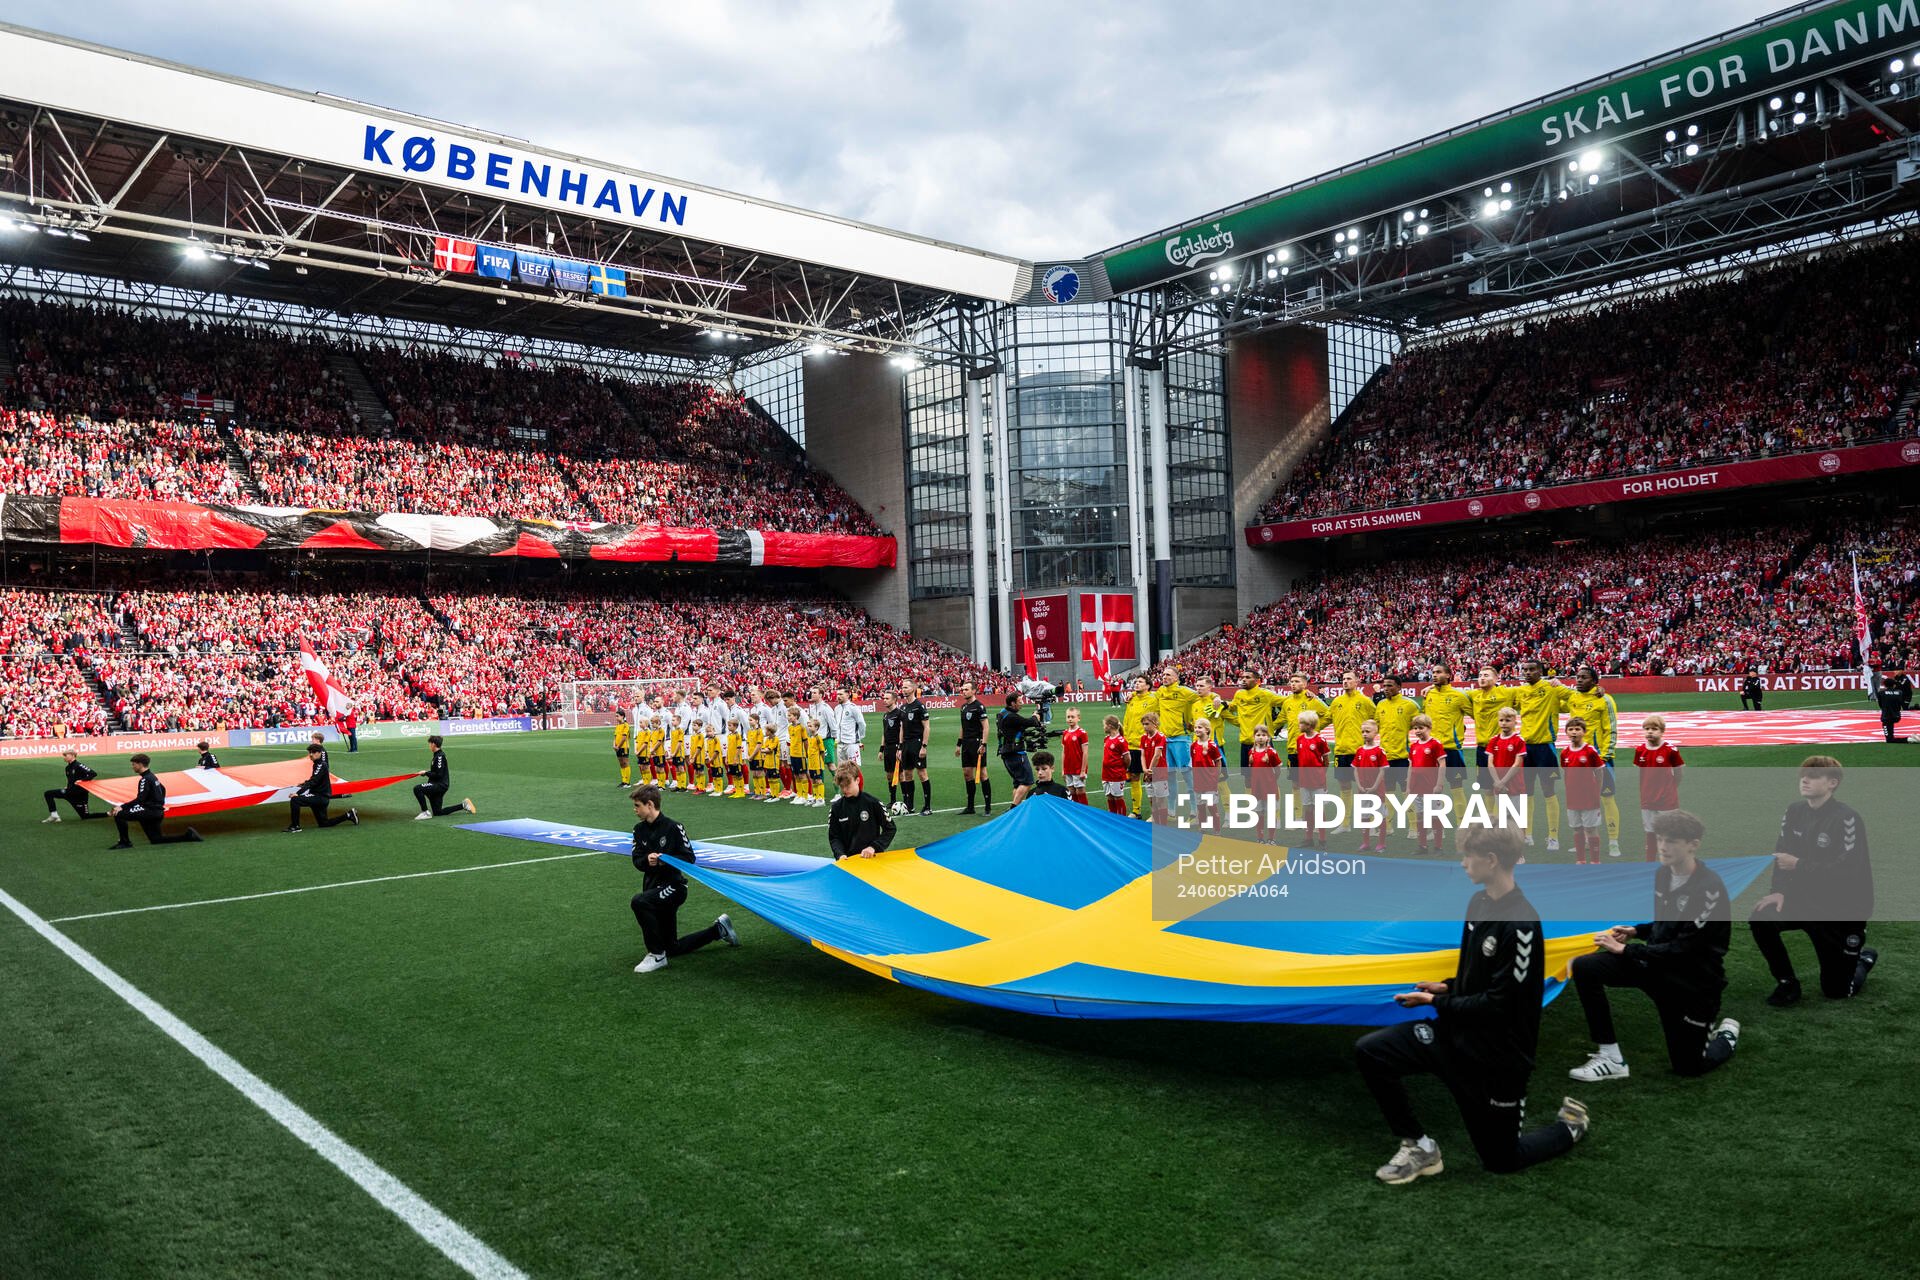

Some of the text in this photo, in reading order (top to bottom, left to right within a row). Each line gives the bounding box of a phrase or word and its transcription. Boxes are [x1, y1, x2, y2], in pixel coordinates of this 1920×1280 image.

[1541, 91, 1645, 147] SKÅL
[1659, 54, 1747, 109] FOR
[363, 125, 688, 227] KØBENHAVN
[1165, 226, 1235, 268] Carlsberg
[483, 254, 511, 270] FIFA
[519, 261, 550, 277] UEFA
[562, 271, 588, 282] RESPECT
[1622, 472, 1719, 495] FOR HOLDET
[1311, 510, 1422, 533] FOR AT STÅ SAMMEN
[1695, 677, 1731, 692] TAK
[1733, 676, 1769, 691] FR
[1773, 675, 1797, 691] AT
[1063, 691, 1103, 703] STØTTE
[400, 724, 431, 737] Carlsberg
[449, 719, 522, 732] Forenet Kredit
